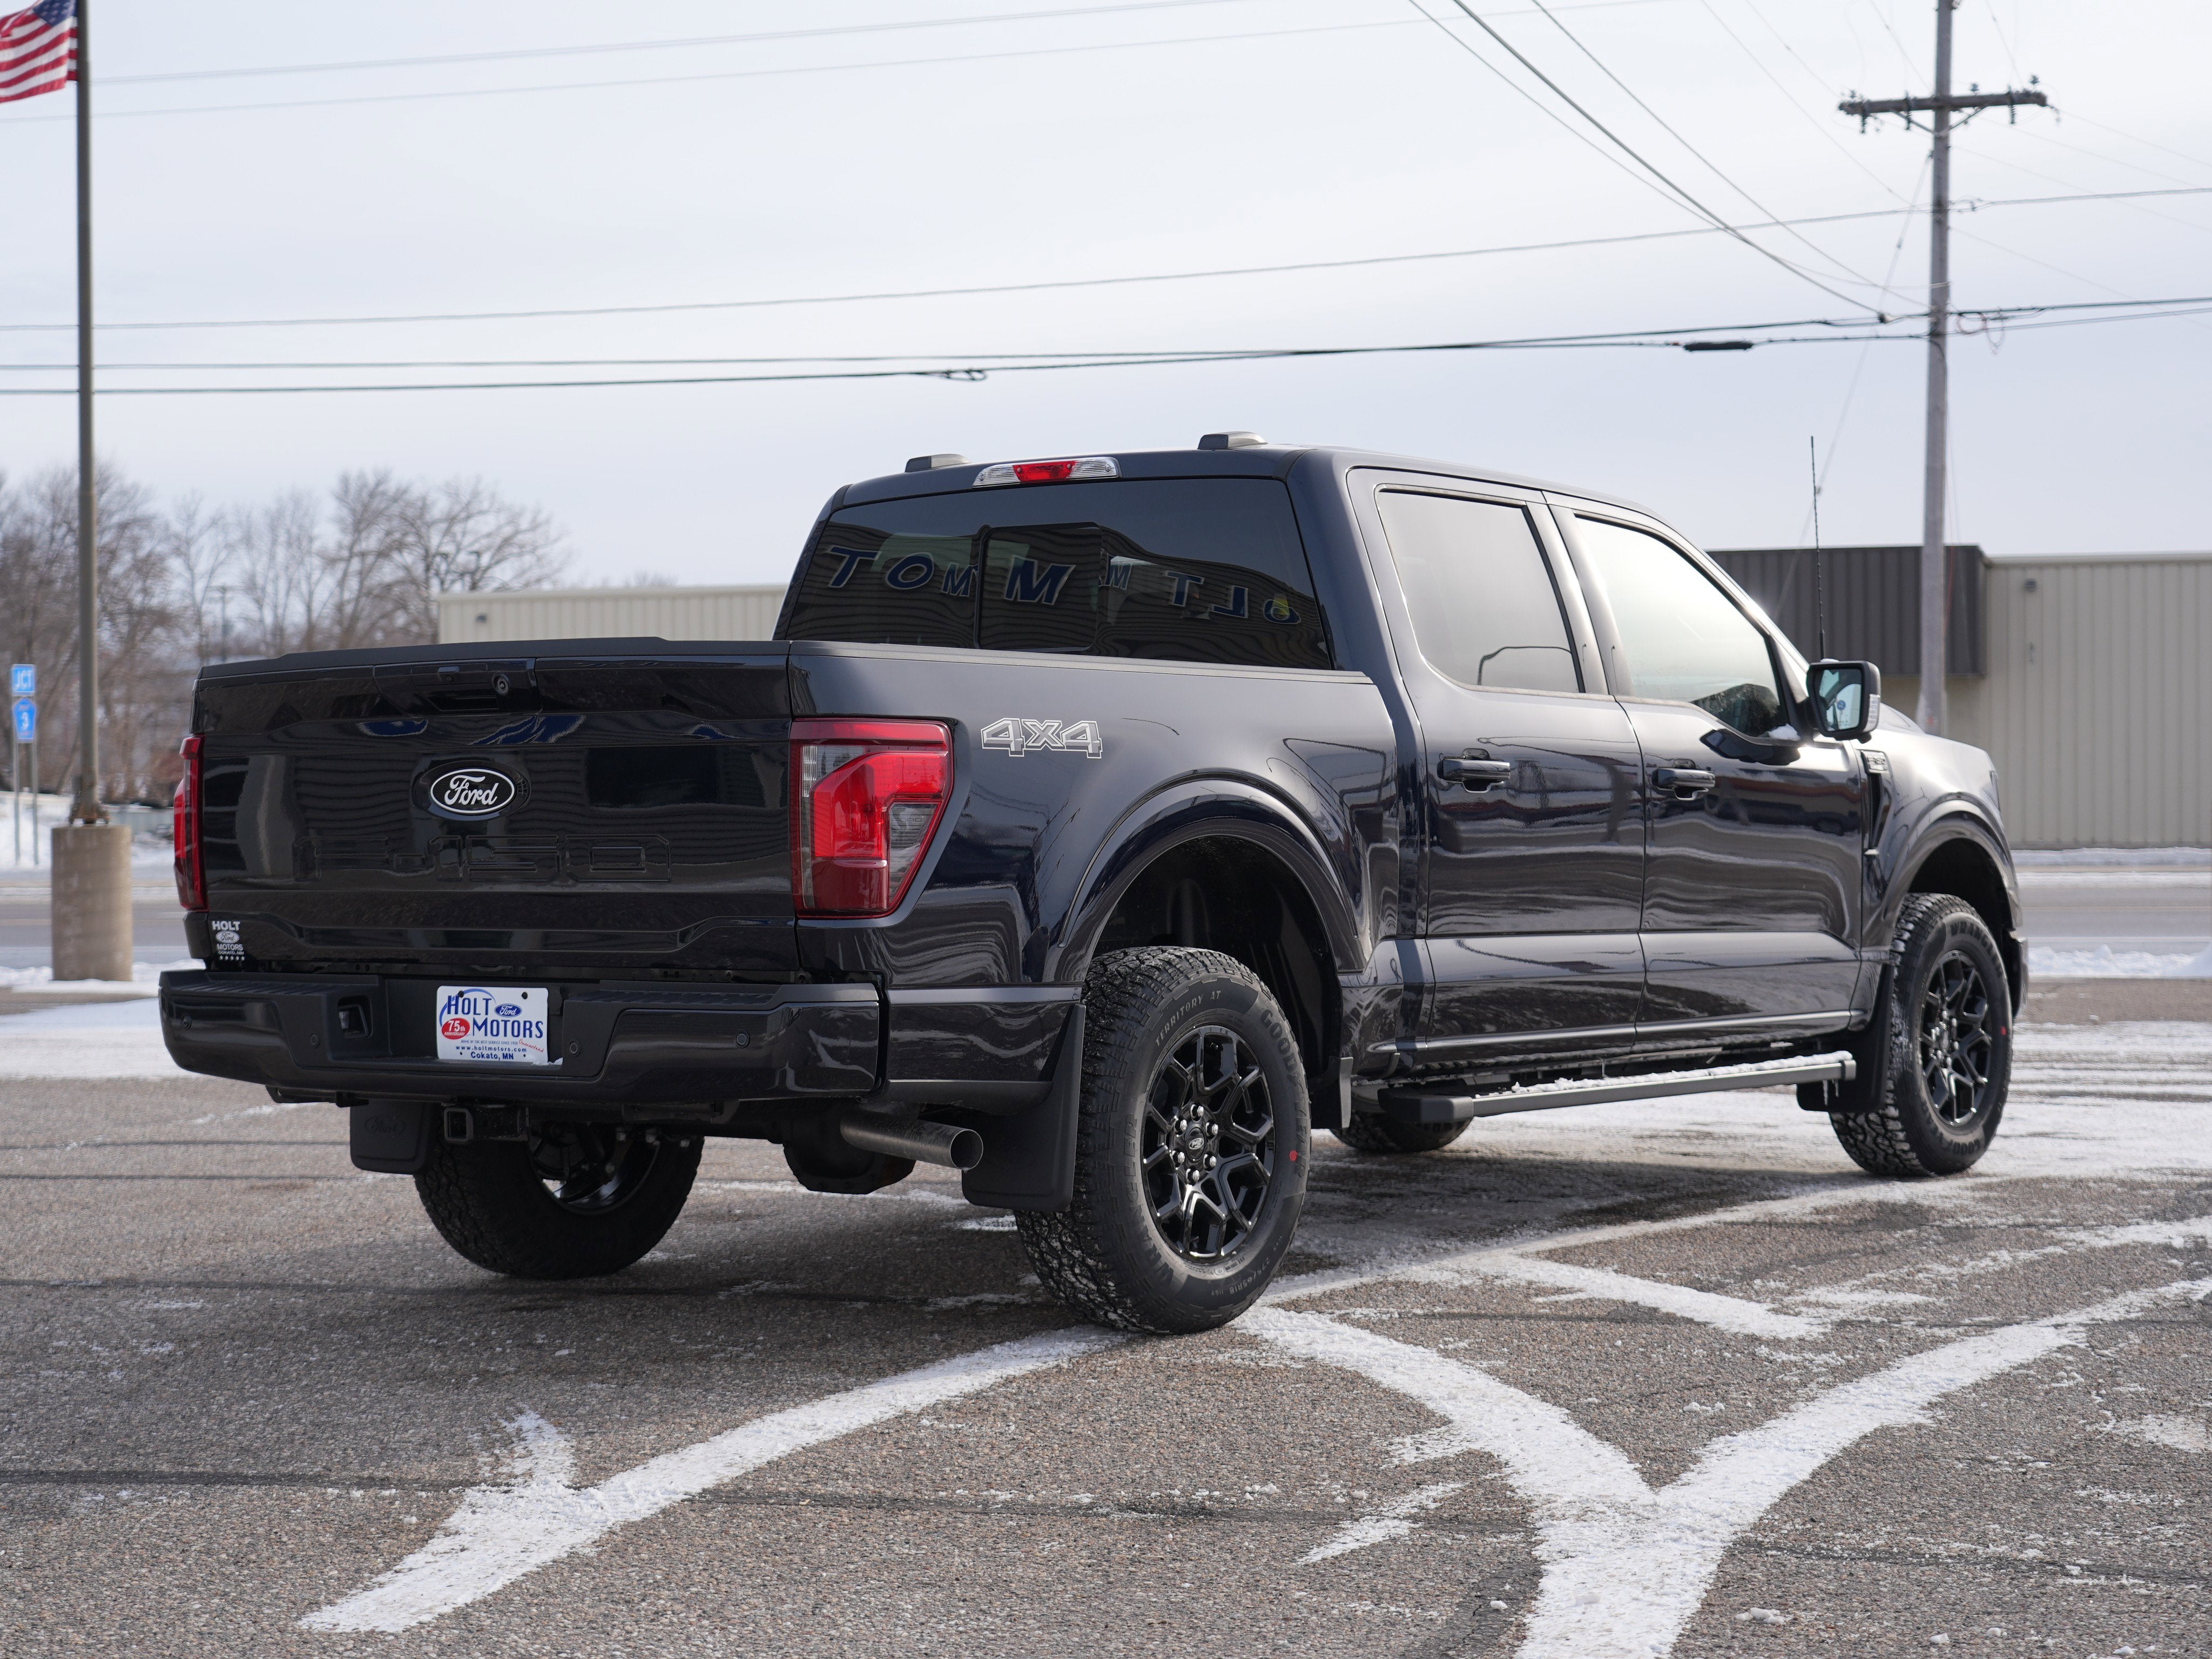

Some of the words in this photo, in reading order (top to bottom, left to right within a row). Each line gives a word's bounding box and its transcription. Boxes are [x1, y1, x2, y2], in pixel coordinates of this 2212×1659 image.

[15, 670, 32, 690] JCT
[444, 774, 500, 806] Ford
[293, 834, 672, 882] F-150
[212, 920, 241, 930] HOLT
[221, 932, 235, 941] Ford
[217, 943, 244, 951] MOTORS
[447, 995, 493, 1016] HOLT
[499, 1005, 517, 1015] Ford
[448, 1020, 466, 1032] 75th
[473, 1016, 543, 1038] MOTORS
[1155, 994, 1204, 1047] TERRITORY
[1210, 990, 1222, 1001] AT
[518, 1038, 544, 1052] Guaranteed
[470, 1051, 501, 1061] Cokato,
[1229, 1257, 1271, 1294] 275/65R18
